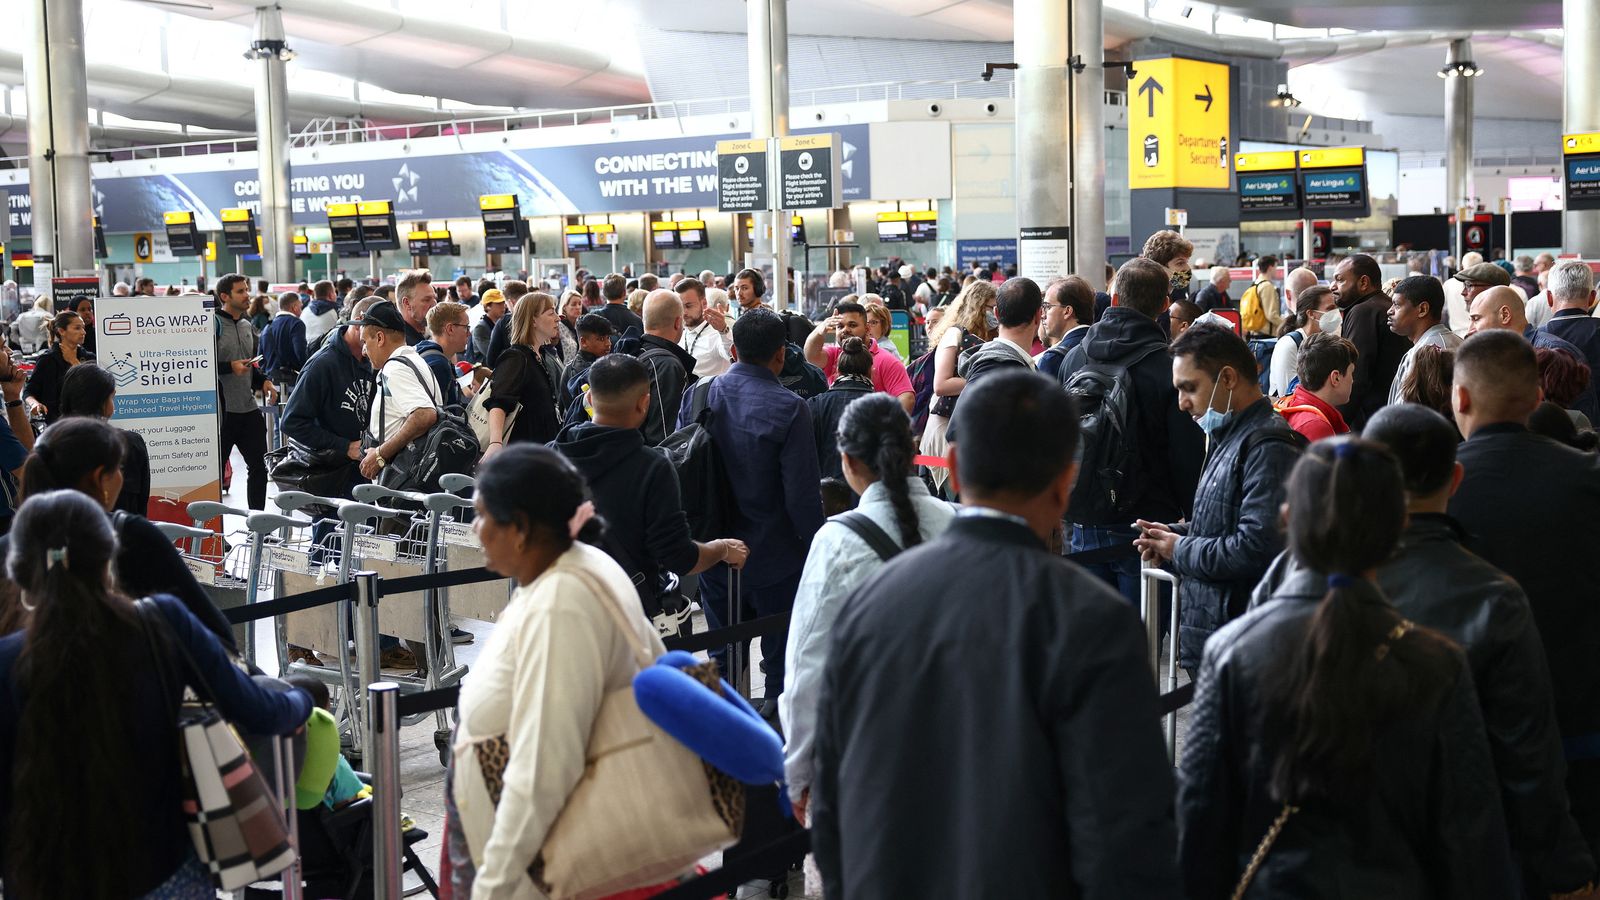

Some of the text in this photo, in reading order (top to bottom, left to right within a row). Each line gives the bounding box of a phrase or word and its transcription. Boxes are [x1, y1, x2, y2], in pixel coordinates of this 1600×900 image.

[1178, 134, 1218, 148] Departures
[1190, 152, 1218, 168] Security
[332, 174, 364, 190] YOU
[600, 178, 648, 197] WITH
[652, 176, 692, 195] THE
[1256, 181, 1279, 191] Lingus
[1322, 179, 1344, 188] Lingus
[136, 315, 208, 327] BAG WRAP
[139, 348, 207, 358] Ultra-Resistant
[140, 358, 208, 372] Hygienic
[141, 372, 192, 386] Shield
[117, 398, 139, 406] Wrap
[161, 396, 180, 404] Bags
[119, 406, 157, 414] Enhanced
[159, 404, 180, 412] Travel
[182, 403, 212, 411] Hygiene
[147, 427, 163, 435] your
[165, 425, 195, 433] Luggage
[149, 439, 173, 447] Germs
[181, 437, 210, 445] Bacteria
[171, 451, 193, 459] Safety
[167, 464, 207, 473] Confidence
